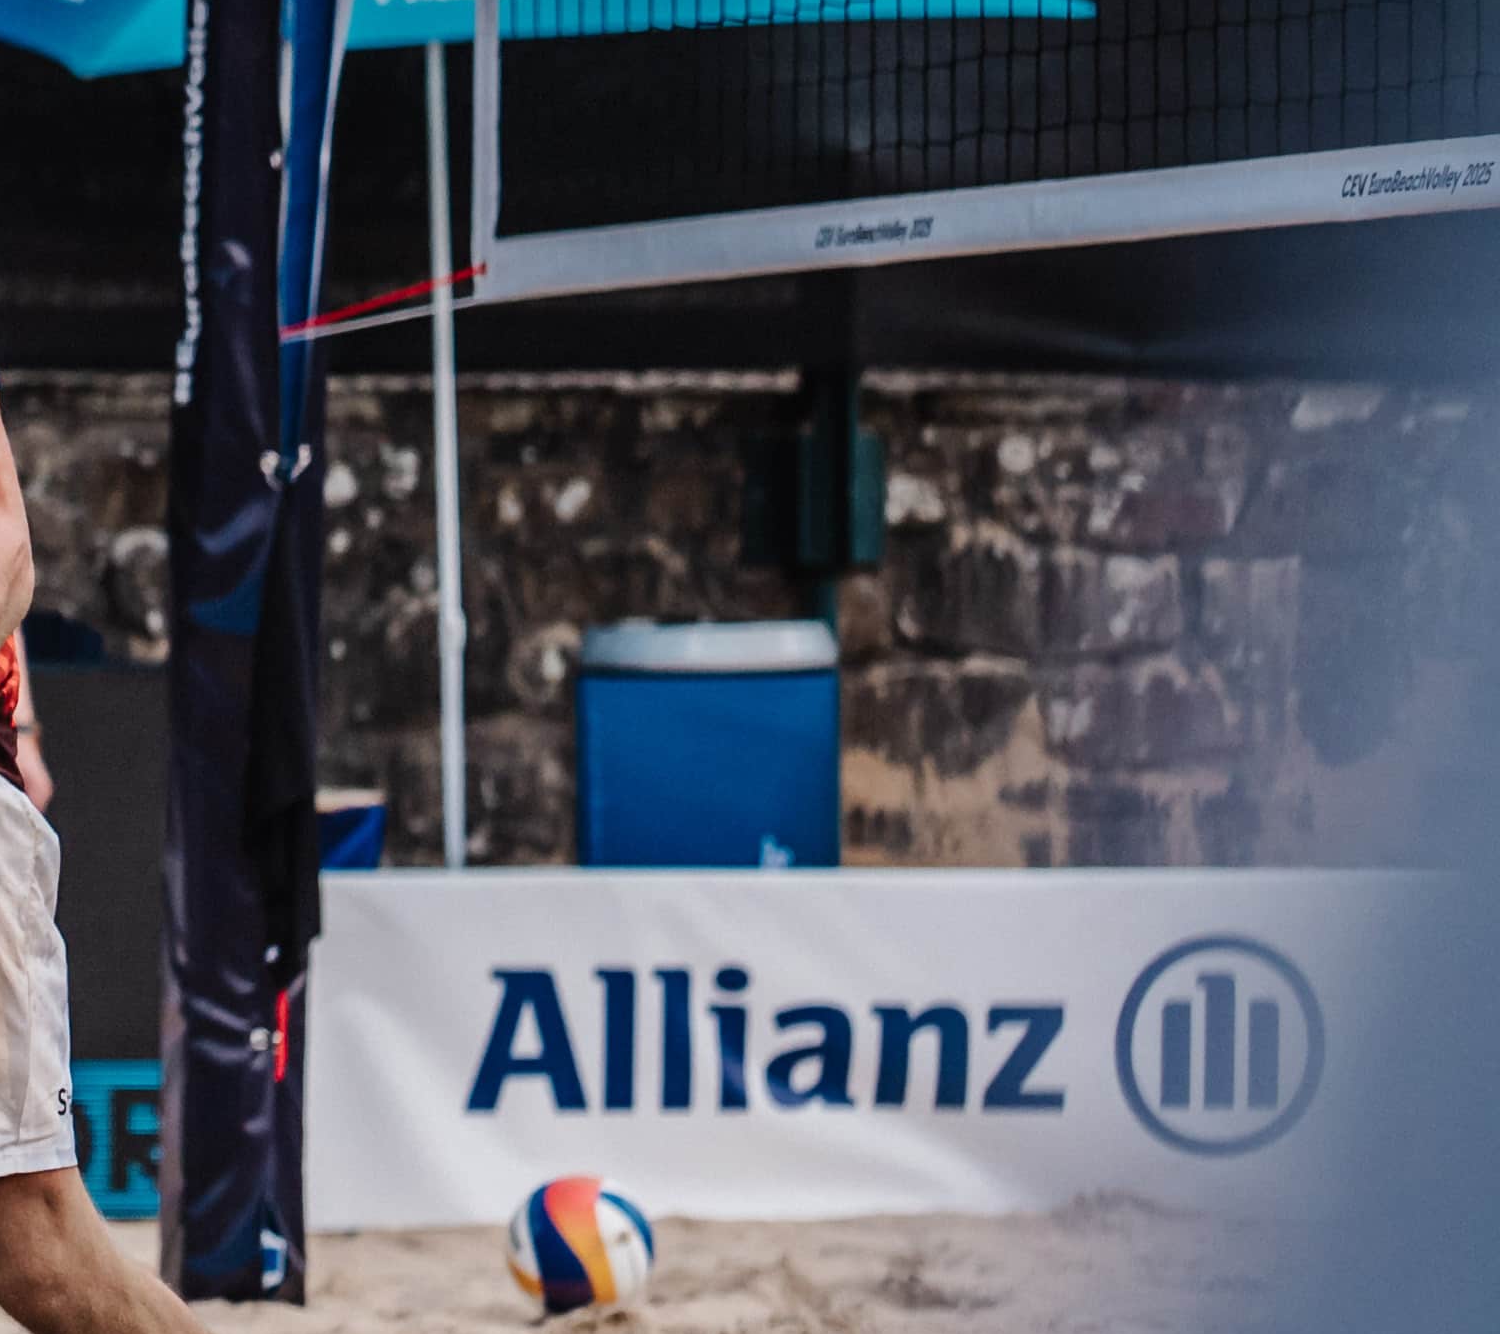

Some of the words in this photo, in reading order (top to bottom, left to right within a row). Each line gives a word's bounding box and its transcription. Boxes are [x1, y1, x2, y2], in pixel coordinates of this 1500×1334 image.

[1341, 173, 1369, 198] CEV
[1367, 165, 1463, 196] EuroBeachVolley
[1461, 160, 1496, 187] 2025
[464, 966, 1067, 1114] Allianz
